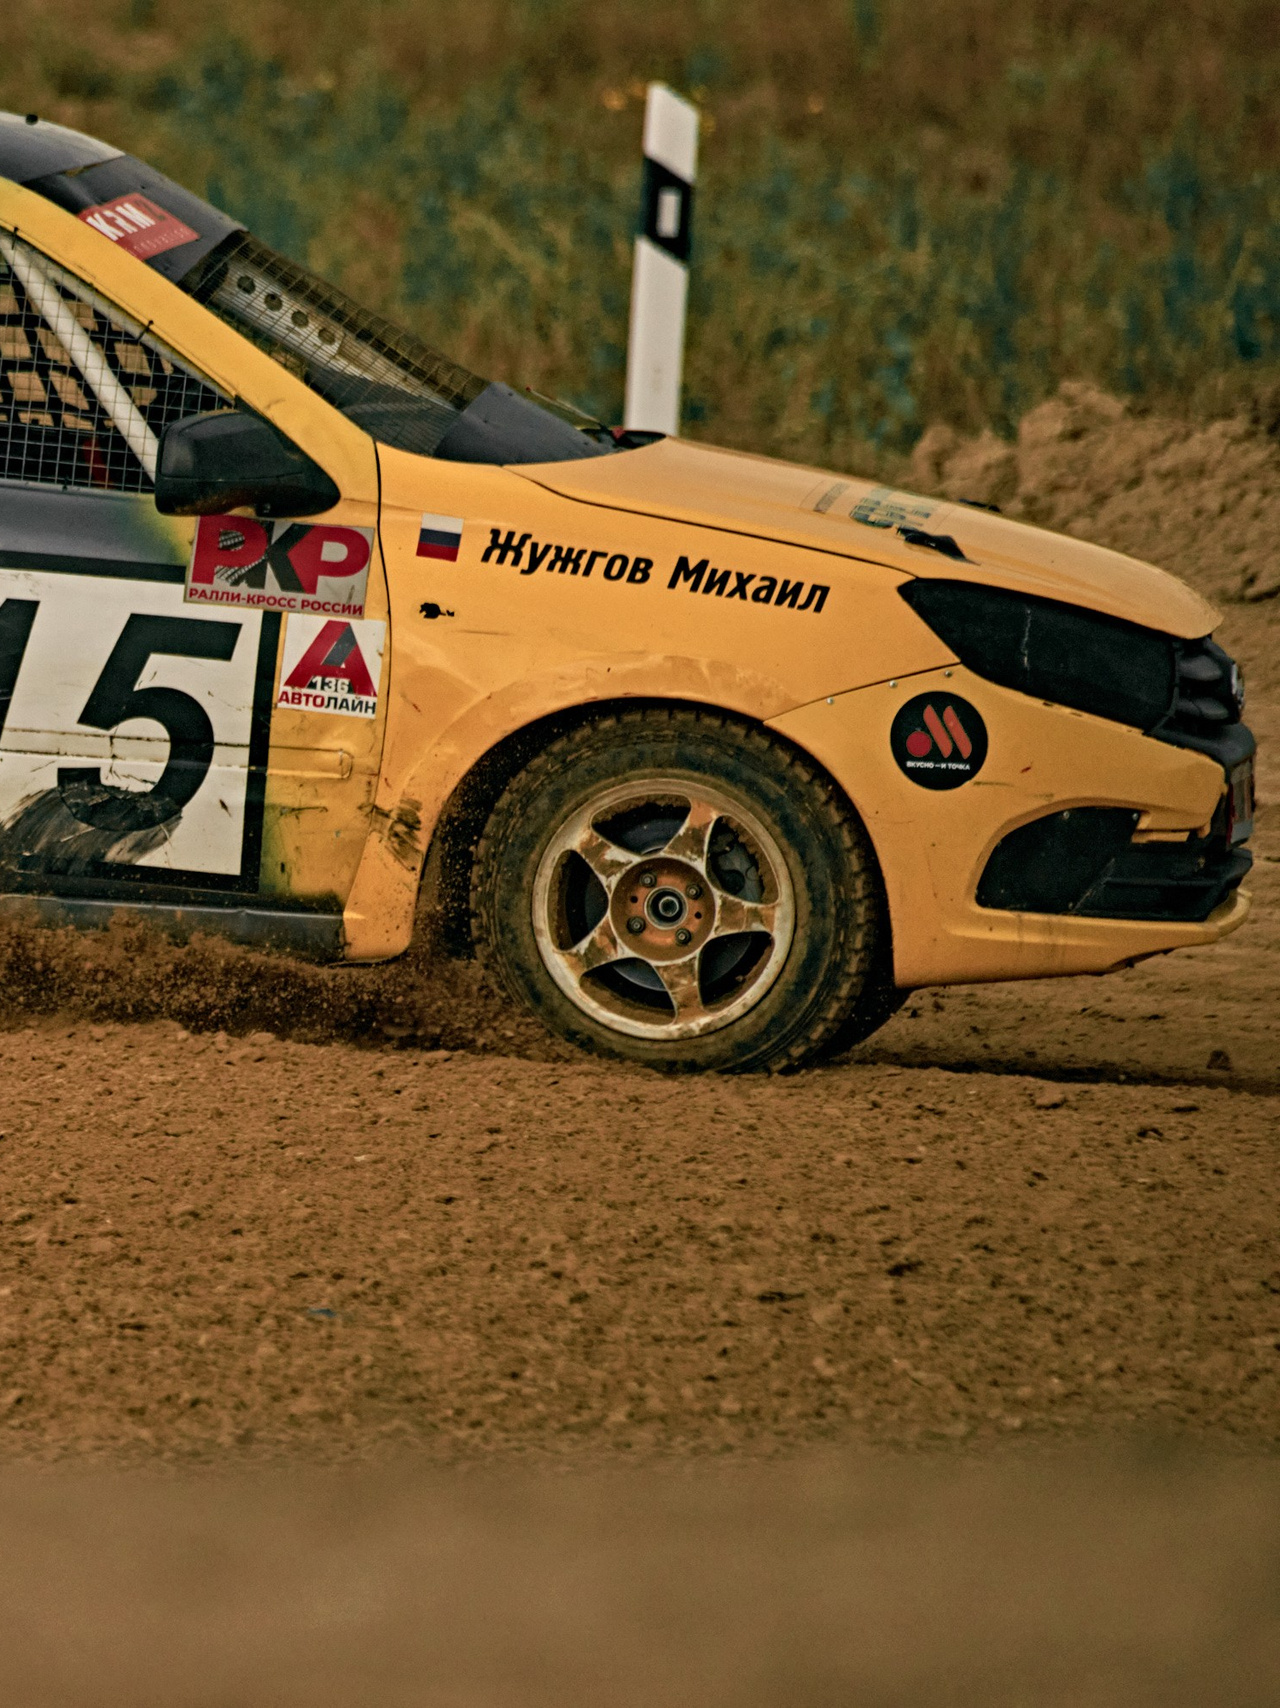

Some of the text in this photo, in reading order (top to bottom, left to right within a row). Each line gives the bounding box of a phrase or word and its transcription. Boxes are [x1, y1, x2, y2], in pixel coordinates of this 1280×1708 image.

[480, 528, 831, 614] Жужгов Михаил
[188, 587, 364, 616] РАЛЛИ-КРОСС РОССИИ
[311, 675, 351, 694] 136
[278, 690, 376, 715] АВТОЛАЙН
[906, 761, 934, 769] ВКУСНО
[947, 762, 971, 770] ТОЧКА
